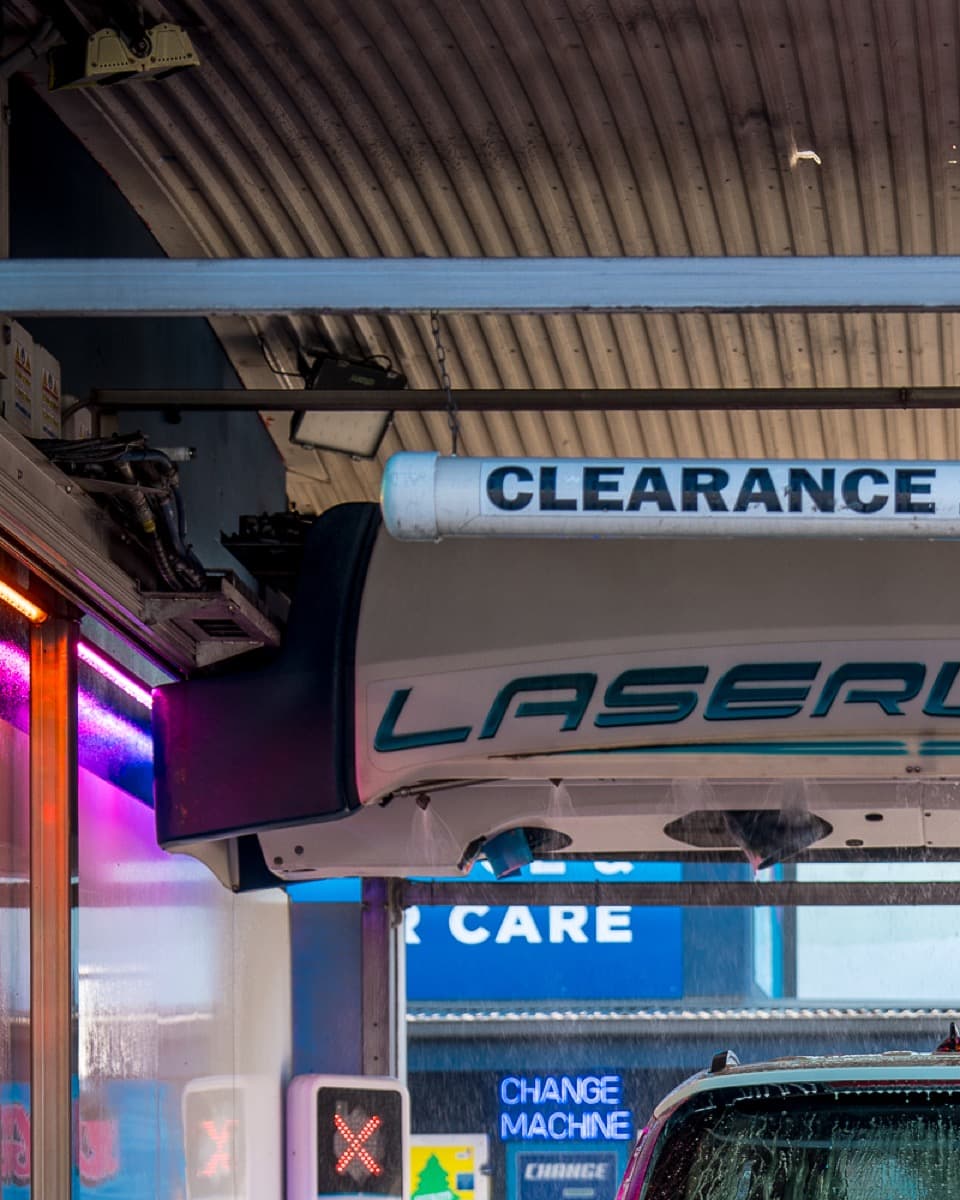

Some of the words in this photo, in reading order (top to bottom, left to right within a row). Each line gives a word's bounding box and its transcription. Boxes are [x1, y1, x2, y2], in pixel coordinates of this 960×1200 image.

[486, 465, 937, 515] CLEARANCE
[448, 905, 633, 944] CARE
[500, 1075, 621, 1105] CHANGE
[500, 1111, 631, 1140] MACHINE
[524, 1162, 609, 1181] CHANGE
